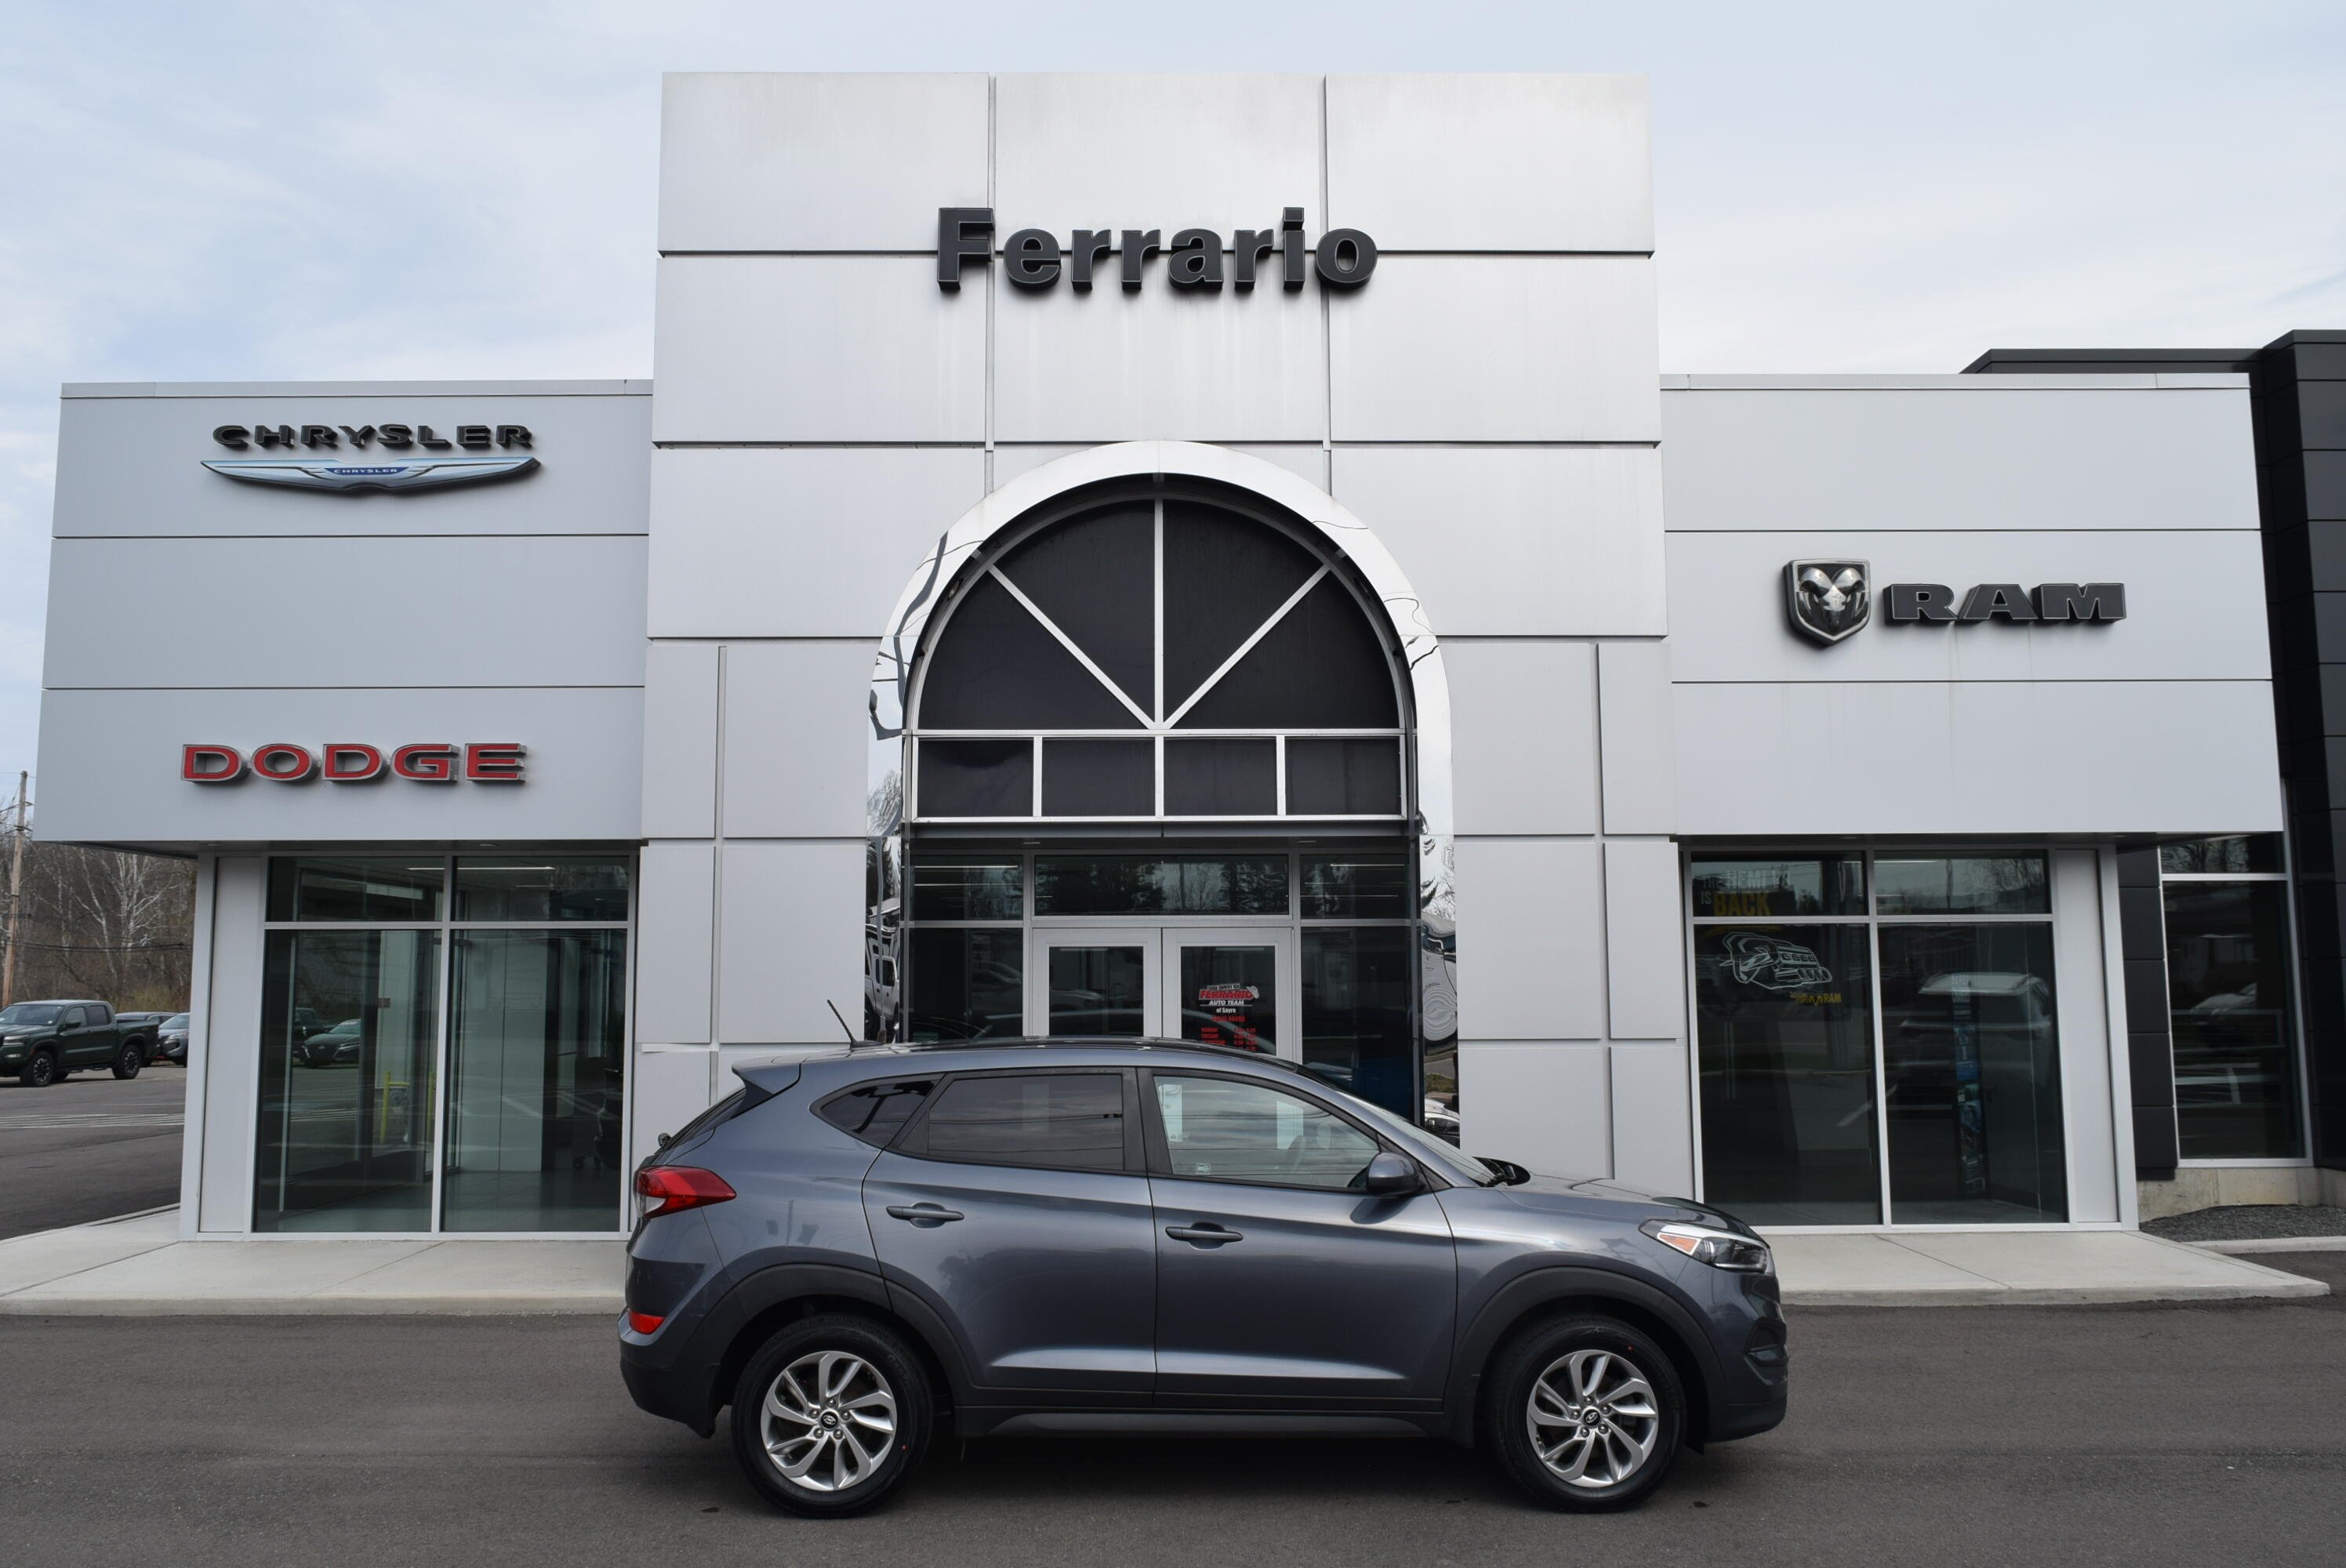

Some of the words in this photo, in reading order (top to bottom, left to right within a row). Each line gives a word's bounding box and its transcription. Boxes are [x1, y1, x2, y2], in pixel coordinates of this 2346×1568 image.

[937, 207, 1378, 290] Ferrario
[212, 424, 535, 449] CHRYSLER
[1882, 583, 2126, 624] RAM
[180, 743, 527, 785] DODGE
[1701, 891, 1712, 905] IS
[1715, 891, 1771, 916] BACK
